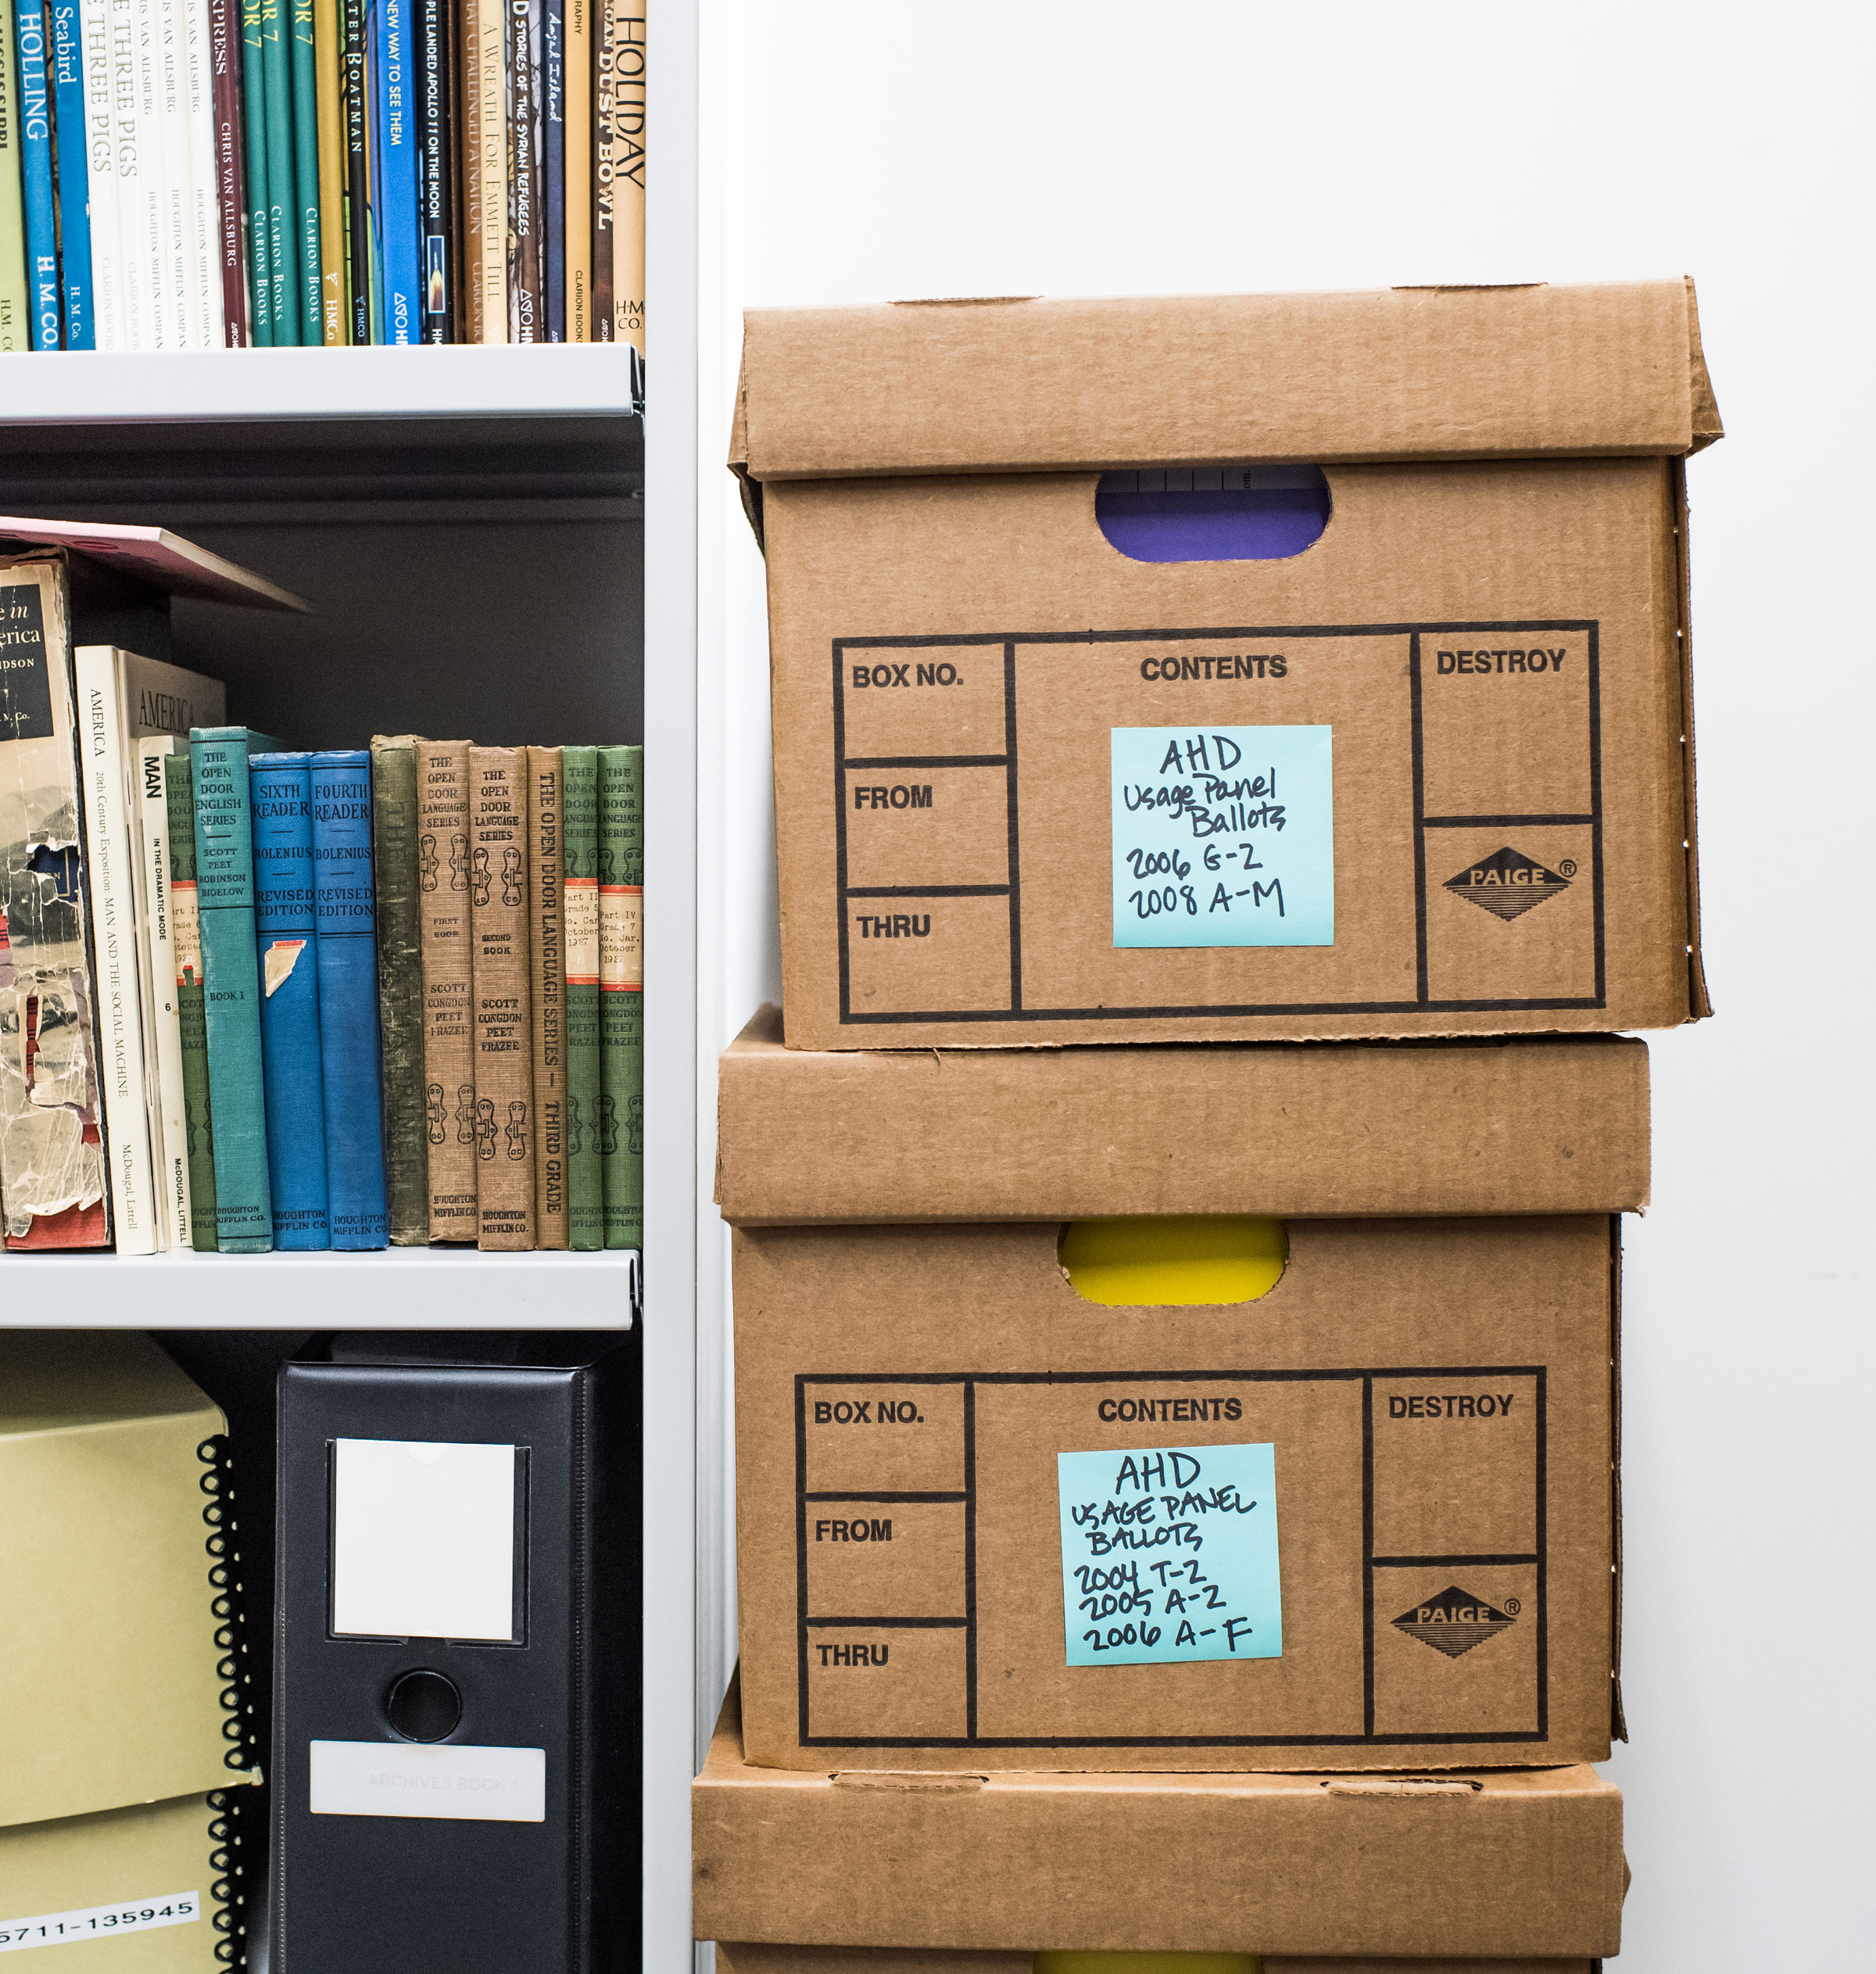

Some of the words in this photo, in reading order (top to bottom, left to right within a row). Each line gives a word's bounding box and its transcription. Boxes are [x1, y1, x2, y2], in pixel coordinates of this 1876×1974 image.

[483, 23, 498, 35] A
[545, 13, 562, 59] Angel
[55, 6, 77, 84] Seabird
[88, 13, 108, 105] THREE
[388, 32, 399, 61] WAY
[426, 24, 438, 70] LANDED
[515, 20, 528, 72] STORIES
[20, 13, 48, 141] HOLLING
[114, 19, 134, 109] THREE
[388, 64, 401, 82] TO
[389, 86, 401, 107] SEE
[427, 71, 439, 118] APOLLO
[483, 45, 499, 124] WREATH
[517, 75, 528, 91] OF
[549, 64, 562, 123] Island
[599, 51, 614, 134] DUST
[346, 52, 363, 152] BOATMAN
[517, 95, 528, 120] THE
[615, 17, 646, 189] HOLIDAY
[389, 111, 402, 146] THEM
[428, 121, 439, 134] 11
[92, 112, 111, 172] PIGS
[119, 118, 138, 177] PIGS
[221, 122, 233, 163] CHRIS
[428, 136, 439, 155] ON
[485, 134, 500, 169] FOR
[517, 123, 529, 170] SYRIAN
[223, 167, 234, 195] VAN
[428, 156, 439, 180] THE
[429, 181, 440, 218] MOON
[517, 173, 530, 236] REFUGEES
[486, 181, 501, 253] EMMETT
[225, 200, 237, 267] ALLSBURG
[254, 210, 266, 272] CLARION
[271, 206, 282, 267] CLARION
[306, 207, 317, 269] CLARION
[38, 256, 55, 278] H.
[40, 282, 56, 310] M.
[487, 262, 502, 302] TILL
[256, 279, 268, 325] BOOKS
[274, 274, 285, 321] BOOKS
[309, 276, 320, 323] BOOKS
[41, 312, 59, 349] CO.
[326, 299, 338, 340] HMCo
[618, 317, 643, 330] CO.
[10, 600, 29, 619] in
[0, 625, 41, 645] erica
[852, 664, 911, 688] BOX
[916, 663, 965, 686] NO.
[1140, 654, 1288, 681] CONTENTS
[1437, 648, 1566, 675] DESTROY
[91, 689, 106, 757] AMERICA
[204, 752, 227, 763] THE
[1160, 734, 1241, 774] AHD
[144, 756, 162, 798] MAN
[201, 768, 231, 779] OPEN
[482, 770, 506, 780] THE
[200, 783, 234, 795] DOOR
[259, 784, 301, 799] SIXTH
[314, 783, 368, 799] FOURTH
[481, 786, 509, 797] OPEN
[539, 772, 554, 808] THE
[854, 785, 933, 810] FROM
[1124, 783, 1197, 819] Usage
[1192, 767, 1276, 804] Panel
[97, 795, 107, 835] Century
[195, 799, 242, 811] ENGLISH
[253, 801, 311, 820] READER
[314, 804, 370, 822] READER
[480, 801, 511, 812] DOOR
[1185, 801, 1287, 837] Ballots
[200, 815, 237, 826] SERIES
[474, 815, 520, 826] LANGUAGE
[153, 838, 160, 847] IN
[479, 830, 514, 841] SERIES
[540, 813, 556, 857] OPEN
[98, 838, 112, 894] Exposition:
[204, 847, 238, 857] SCOTT
[208, 861, 232, 869] PEET
[255, 847, 313, 860] BOLENIUS
[316, 847, 371, 860] BOLENIUS
[1126, 848, 1191, 880] 2006
[156, 868, 165, 913] DRAMATIC
[199, 873, 246, 883] ROBINSON
[541, 863, 557, 909] DOOR
[1470, 868, 1546, 887] PAIGE
[202, 887, 245, 897] BIGELOW
[257, 889, 313, 902] REVISED
[318, 888, 373, 901] REVISED
[1128, 885, 1197, 919] 2008
[1209, 878, 1285, 917] A-M
[105, 897, 116, 926] MAN
[257, 904, 313, 917] EDITION
[318, 904, 374, 918] EDITION
[625, 911, 636, 919] IV
[158, 915, 166, 940] MODE
[482, 933, 511, 942] SECOND
[856, 914, 931, 938] THRU
[107, 931, 118, 958] AND
[483, 946, 511, 955] BOOK
[542, 914, 557, 1004] LANGUAGE
[109, 962, 120, 987] THE
[165, 1002, 171, 1012] 6
[209, 991, 238, 1001] BOOK
[481, 998, 519, 1008] SCOTT
[111, 991, 123, 1035] SOCIAL
[478, 1012, 522, 1023] CONGDON
[485, 1026, 514, 1037] PEET
[543, 1008, 559, 1066] SERIES
[481, 1041, 520, 1051] FRAZEE
[115, 1038, 128, 1098] MACHINE
[545, 1101, 560, 1155] THIRD
[122, 1144, 135, 1197] McDougal,
[174, 1158, 184, 1208] McDOUGAL,
[546, 1159, 562, 1213] GRADE
[127, 1199, 138, 1230] Littell
[178, 1209, 187, 1243] LITTELL
[334, 1213, 386, 1225] HOUGHTON
[482, 1210, 527, 1220] HOUGHTON
[814, 1401, 872, 1424] BOX
[877, 1401, 924, 1424] NO.
[1097, 1397, 1243, 1422] CONTENTS
[1389, 1394, 1515, 1419] DESTROY
[1115, 1452, 1201, 1495] AHD
[1072, 1496, 1156, 1530] USAGE
[1160, 1485, 1257, 1521] PANEL
[815, 1519, 892, 1542] FROM
[1085, 1522, 1203, 1556] BALLOTS
[1073, 1560, 1139, 1594] 2004
[1079, 1589, 1154, 1621] 2005
[1416, 1607, 1491, 1623] PAIGE
[1083, 1621, 1162, 1651] 2006
[816, 1643, 889, 1667] THRU
[367, 1773, 452, 1790] ARCHIVES
[457, 1777, 507, 1793] BOOK
